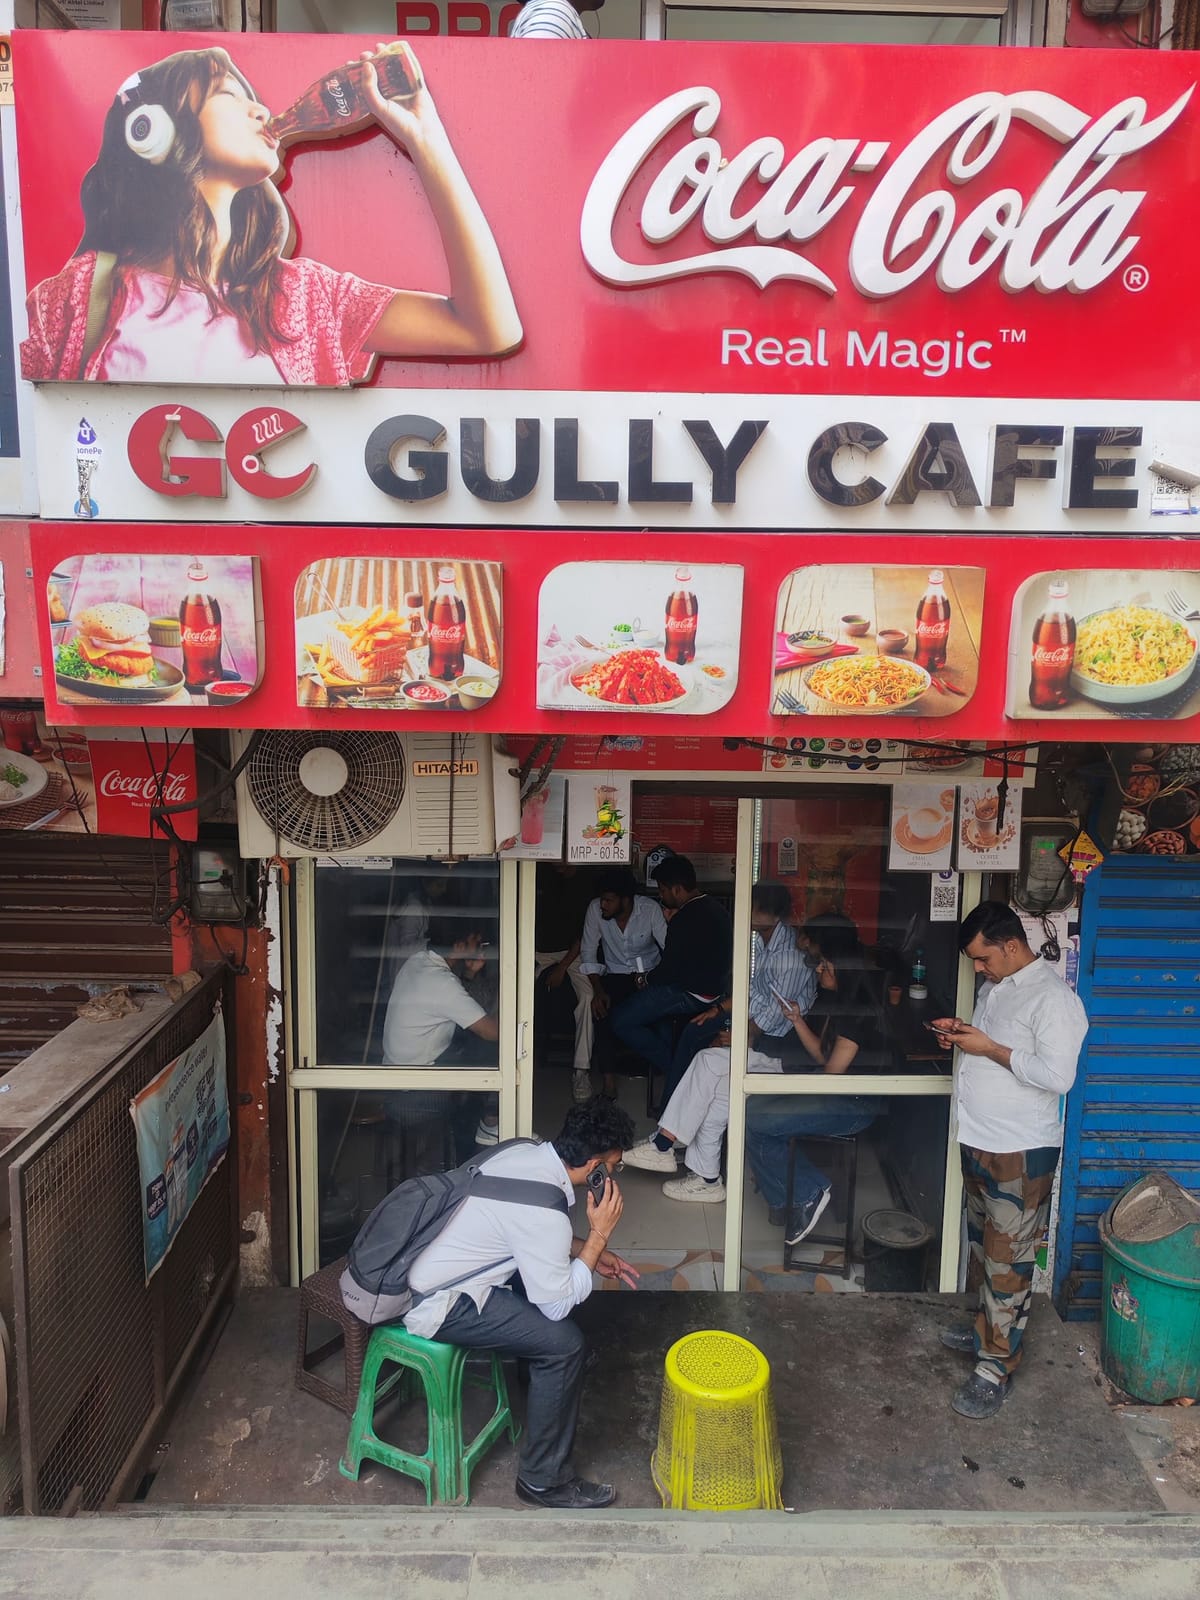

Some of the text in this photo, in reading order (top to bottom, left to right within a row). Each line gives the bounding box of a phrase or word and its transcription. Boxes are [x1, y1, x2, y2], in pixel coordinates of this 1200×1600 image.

[580, 82, 1197, 298] Coca-Cola
[721, 329, 829, 367] Real
[845, 330, 992, 377] Magic
[364, 413, 769, 504] GULLY
[806, 421, 1144, 510] CAFE
[417, 763, 474, 774] HITACHI
[570, 846, 592, 860] MRP
[599, 846, 611, 860] 60
[612, 846, 627, 860] Rs.
